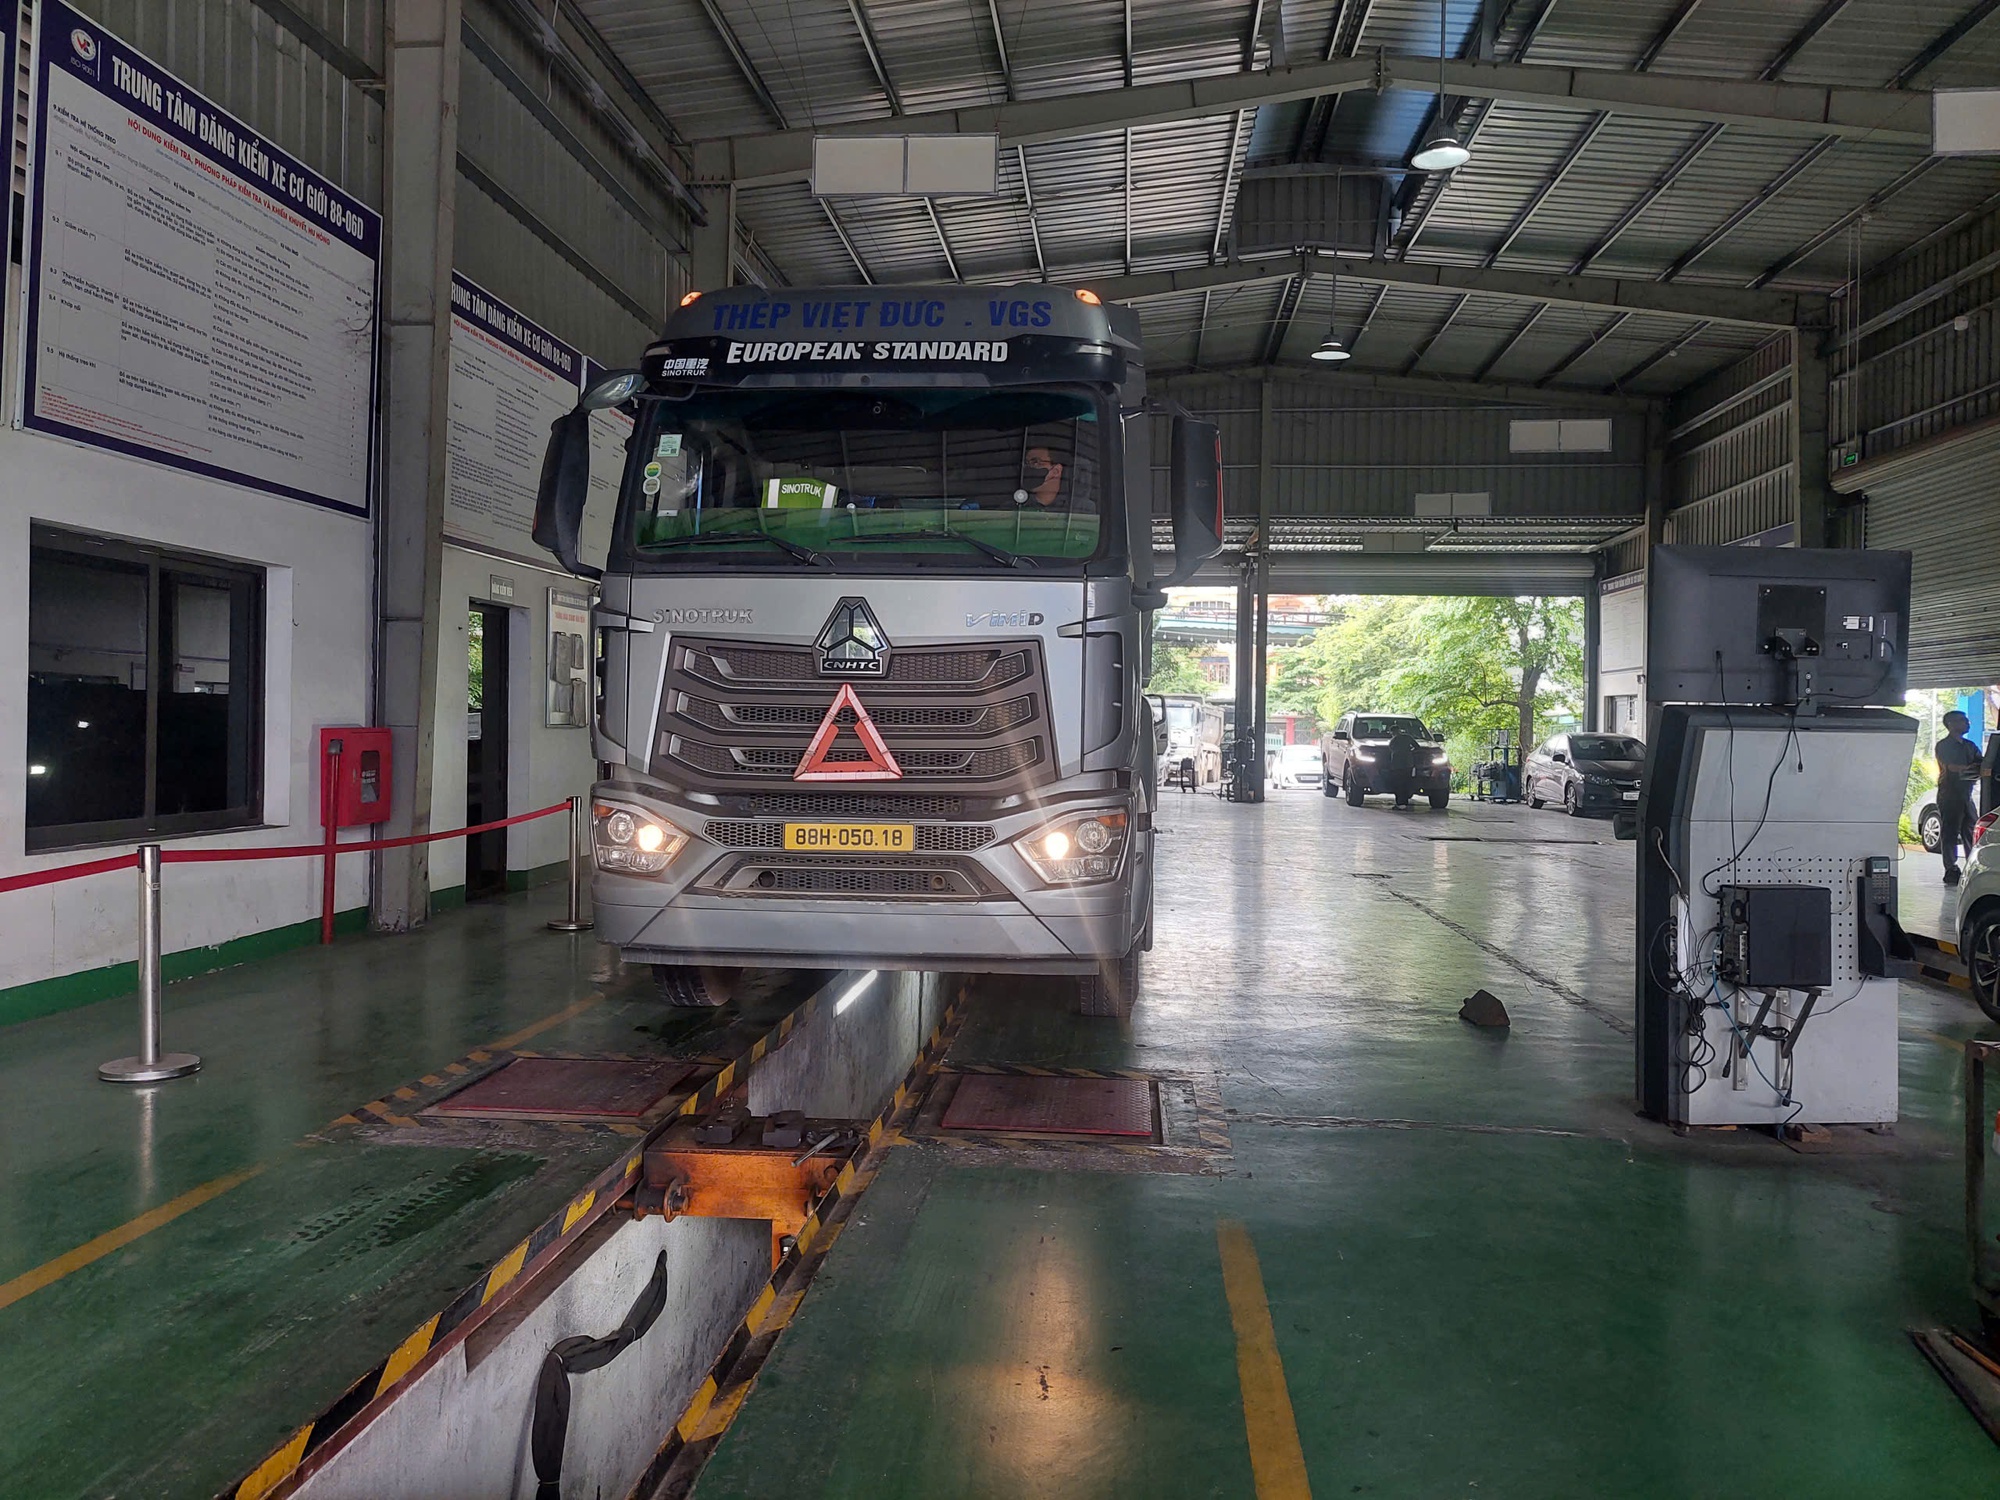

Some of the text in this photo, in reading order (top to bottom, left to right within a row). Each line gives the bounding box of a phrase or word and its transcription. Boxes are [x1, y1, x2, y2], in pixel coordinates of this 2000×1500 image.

[112, 55, 162, 114] TRUNG
[166, 92, 196, 135] TÂM
[199, 113, 235, 159] ĐĂNG
[239, 139, 269, 180] KIỂM
[271, 163, 286, 193] XE
[289, 172, 305, 203] CƠ
[307, 184, 328, 218] GIỚI
[330, 200, 364, 241] 88-06D
[127, 116, 140, 134] NỘI
[142, 125, 161, 144] DUNG
[163, 137, 178, 154] KIỂM
[194, 157, 220, 180] PHƯƠNG
[221, 173, 236, 190] PHÁP
[252, 192, 261, 204] TRA
[451, 281, 471, 311] RUNG
[472, 293, 487, 321] TÂM
[507, 315, 523, 342] KIỂM
[523, 329, 531, 348] XE
[989, 300, 1052, 327] VGS
[726, 341, 1009, 364] EUROPEAN STANDARD
[661, 369, 706, 377] SINOTRUK
[663, 357, 710, 370] 中国重汽
[780, 482, 823, 498] SINOTRUK
[823, 660, 879, 670] CNHTC
[796, 828, 903, 847] 88H-050.18
